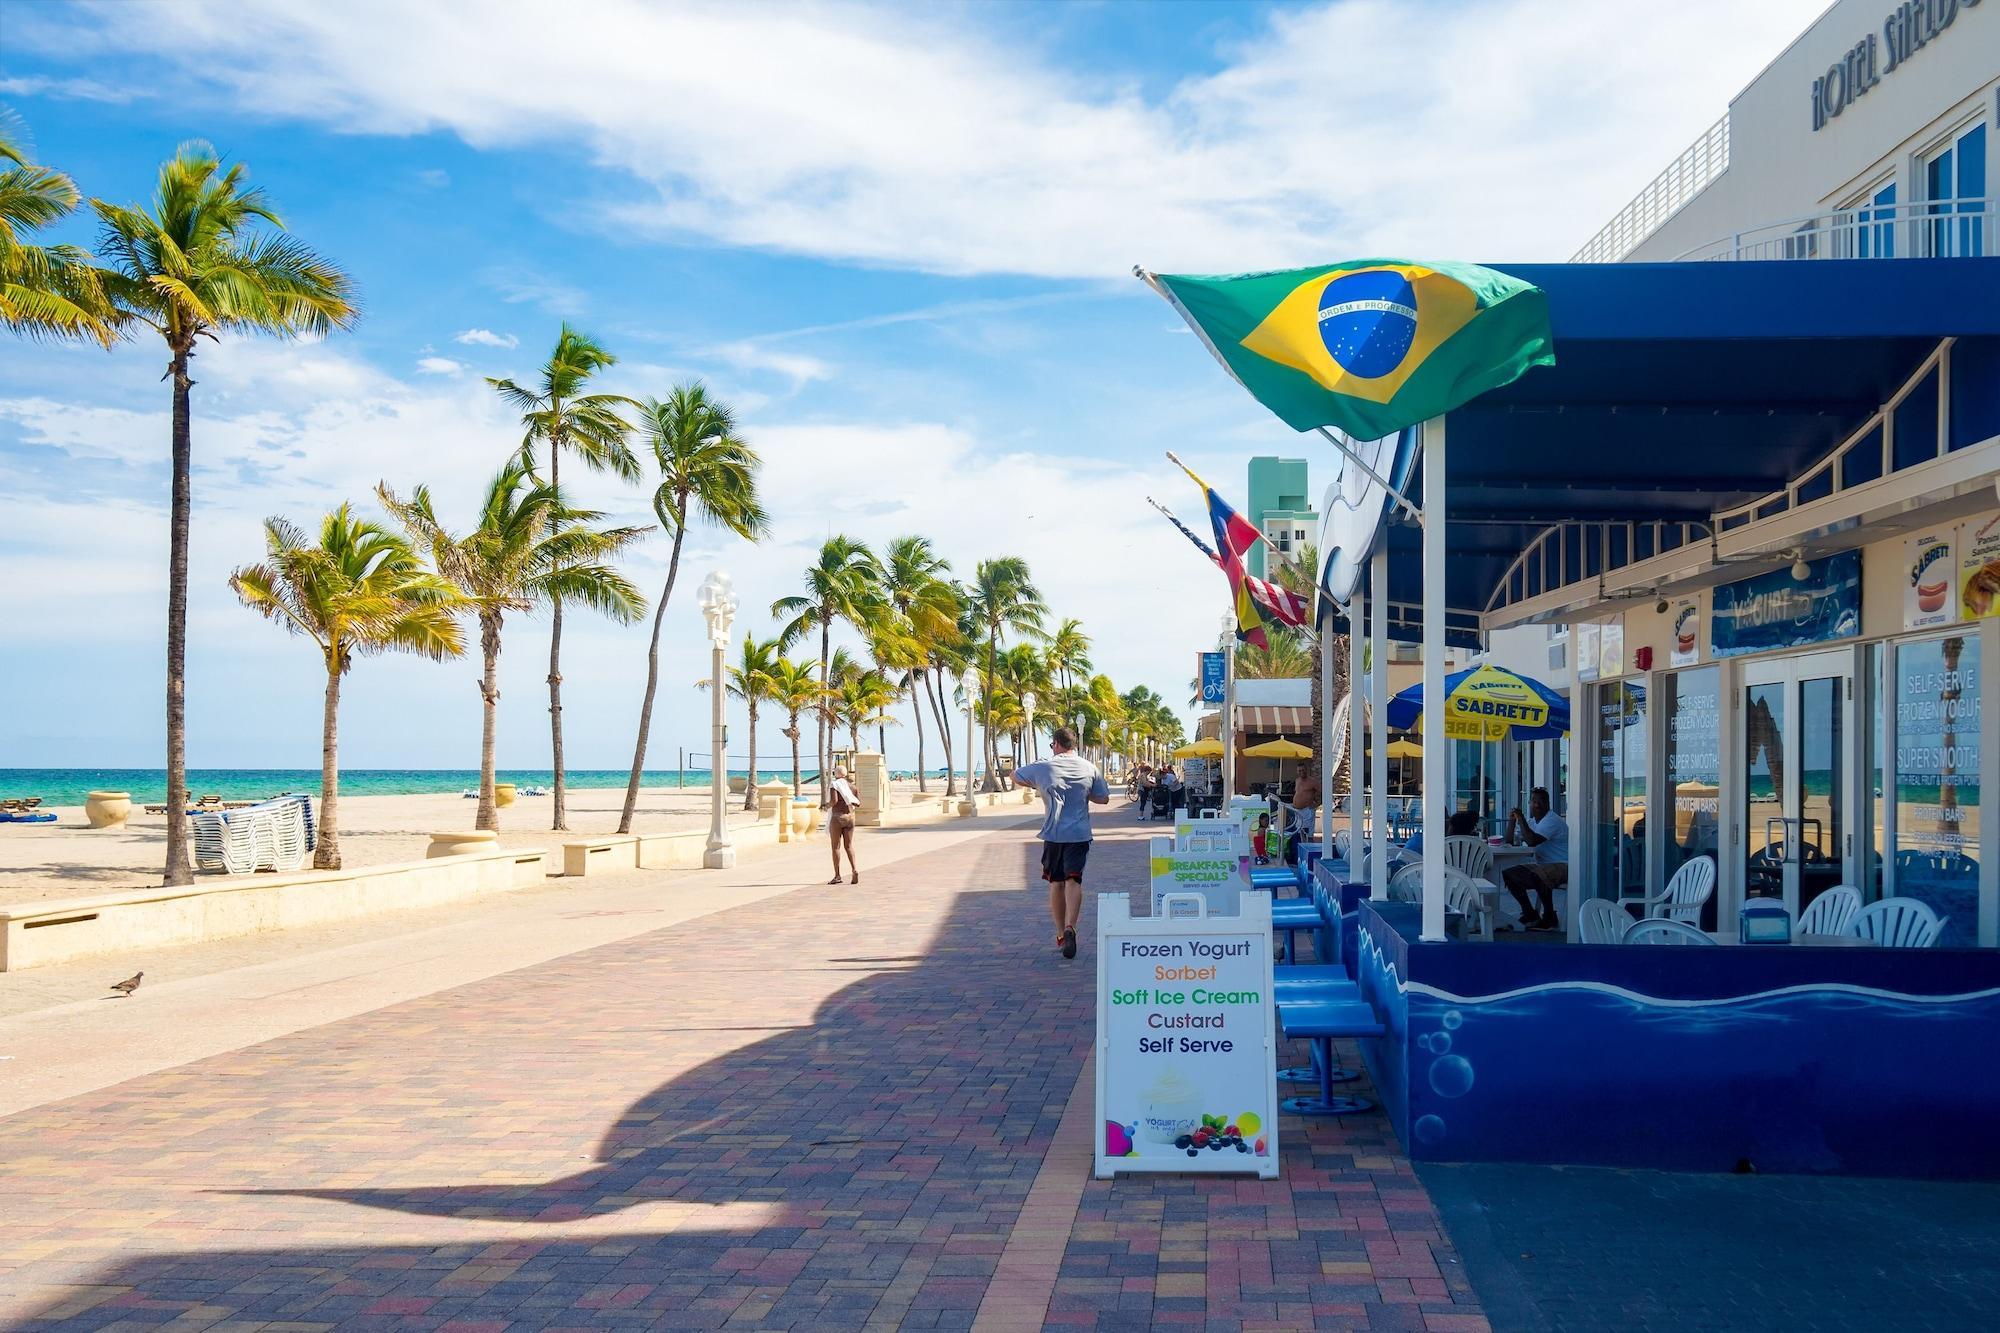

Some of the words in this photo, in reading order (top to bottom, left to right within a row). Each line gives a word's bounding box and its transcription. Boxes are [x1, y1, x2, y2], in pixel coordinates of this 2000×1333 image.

[1811, 33, 1880, 131] HOTEL
[1883, 0, 1982, 74] SHELD
[1320, 304, 1353, 319] ORDEM
[1364, 301, 1415, 317] PROGRESSO
[1911, 544, 1949, 588] SABRETT
[1732, 587, 1792, 630] YOGURT
[1469, 682, 1523, 690] SABRETT
[1908, 669, 1975, 694] SELF-SERVE
[1456, 698, 1543, 721] SABRETT
[1677, 695, 1714, 711] SELF-SERVE
[1898, 701, 1939, 721] FROZEN
[1941, 698, 1981, 719] YOGUR
[1671, 716, 1695, 730] FROZEN
[1696, 713, 1720, 729] YOGUR
[1669, 754, 1690, 770] SUPER
[1897, 748, 1930, 769] SUPER
[1675, 797, 1700, 811] PROTEIN
[1701, 797, 1718, 813] BARS
[1913, 807, 1944, 821] PROTEIN
[1945, 808, 1967, 822] BARS
[1167, 860, 1234, 871] BREAKFAST
[1175, 872, 1228, 881] SPECIALS
[1121, 942, 1183, 957] Frozen
[1188, 940, 1251, 960] Yogurt
[1155, 965, 1217, 980] Sorbet
[1112, 989, 1149, 1005] Soft
[1155, 989, 1185, 1004] Ice
[1192, 988, 1260, 1004] Cream
[1148, 1013, 1224, 1028] Custard
[1139, 1037, 1174, 1053] Self
[1180, 1037, 1233, 1053] Serve
[1145, 1118, 1176, 1126] YOGURT
